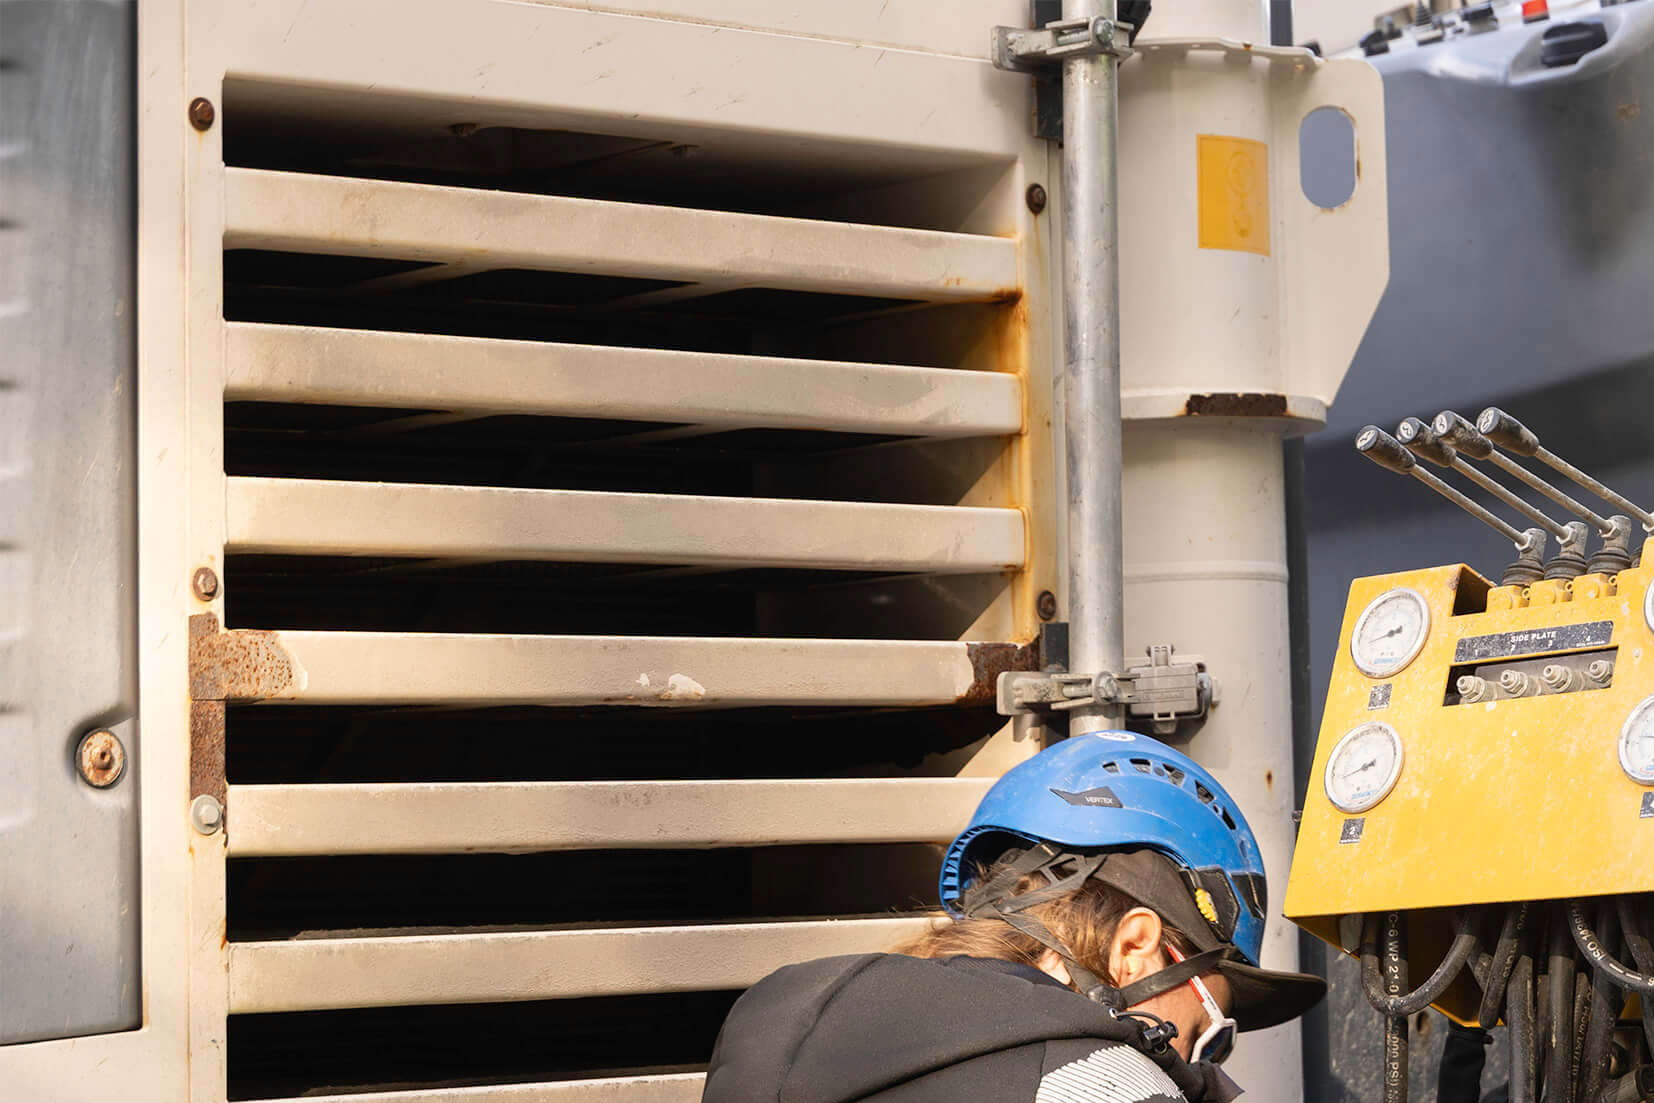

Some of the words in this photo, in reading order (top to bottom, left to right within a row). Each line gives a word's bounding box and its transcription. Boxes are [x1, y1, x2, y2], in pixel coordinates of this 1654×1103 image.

[1510, 632, 1529, 643] SIDE
[1530, 630, 1557, 641] PLATE
[1586, 940, 1606, 961] ISO
